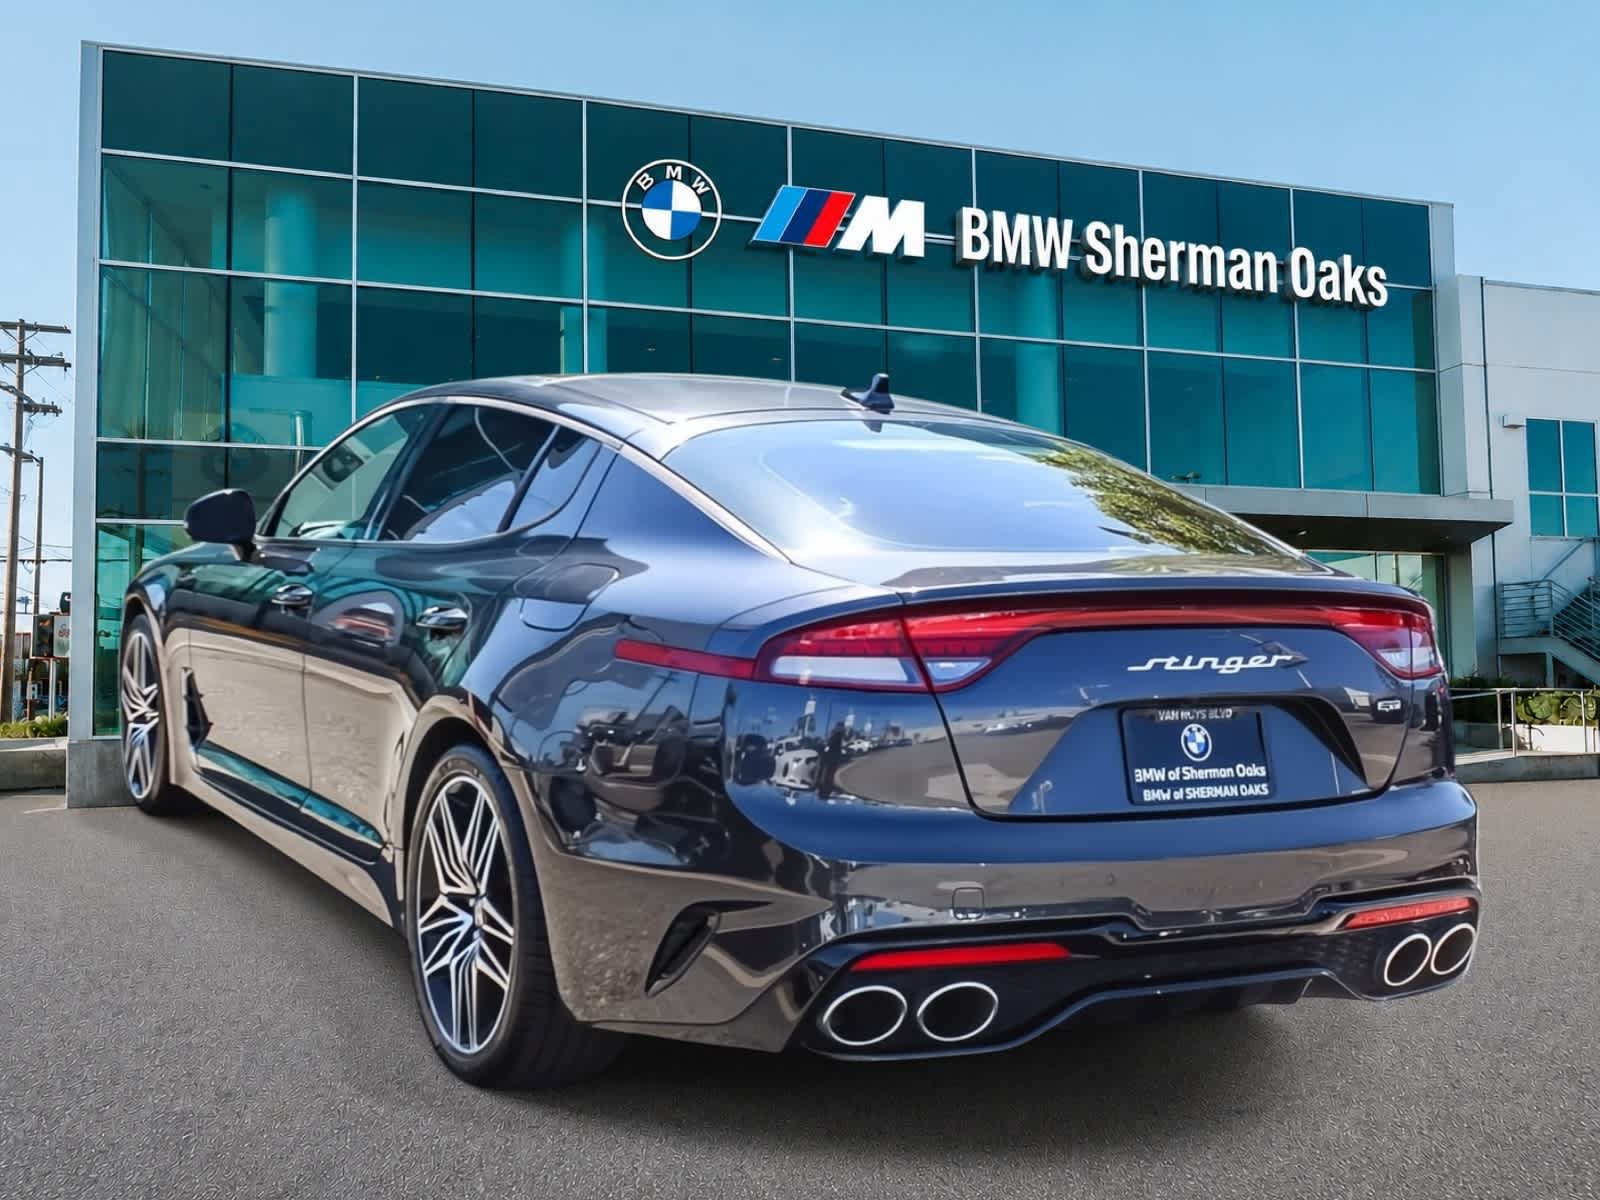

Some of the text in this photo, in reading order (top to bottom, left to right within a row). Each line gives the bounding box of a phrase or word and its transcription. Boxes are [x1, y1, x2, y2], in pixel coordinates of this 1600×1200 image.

[636, 165, 711, 196] BMW
[834, 195, 925, 257] M
[960, 206, 1389, 308] BMW Sherman Oaks
[1127, 654, 1293, 674] stinger
[1134, 763, 1267, 783] BMW of Sherman Oaks
[1143, 783, 1269, 802] BMW of SHERMAN OAKS
